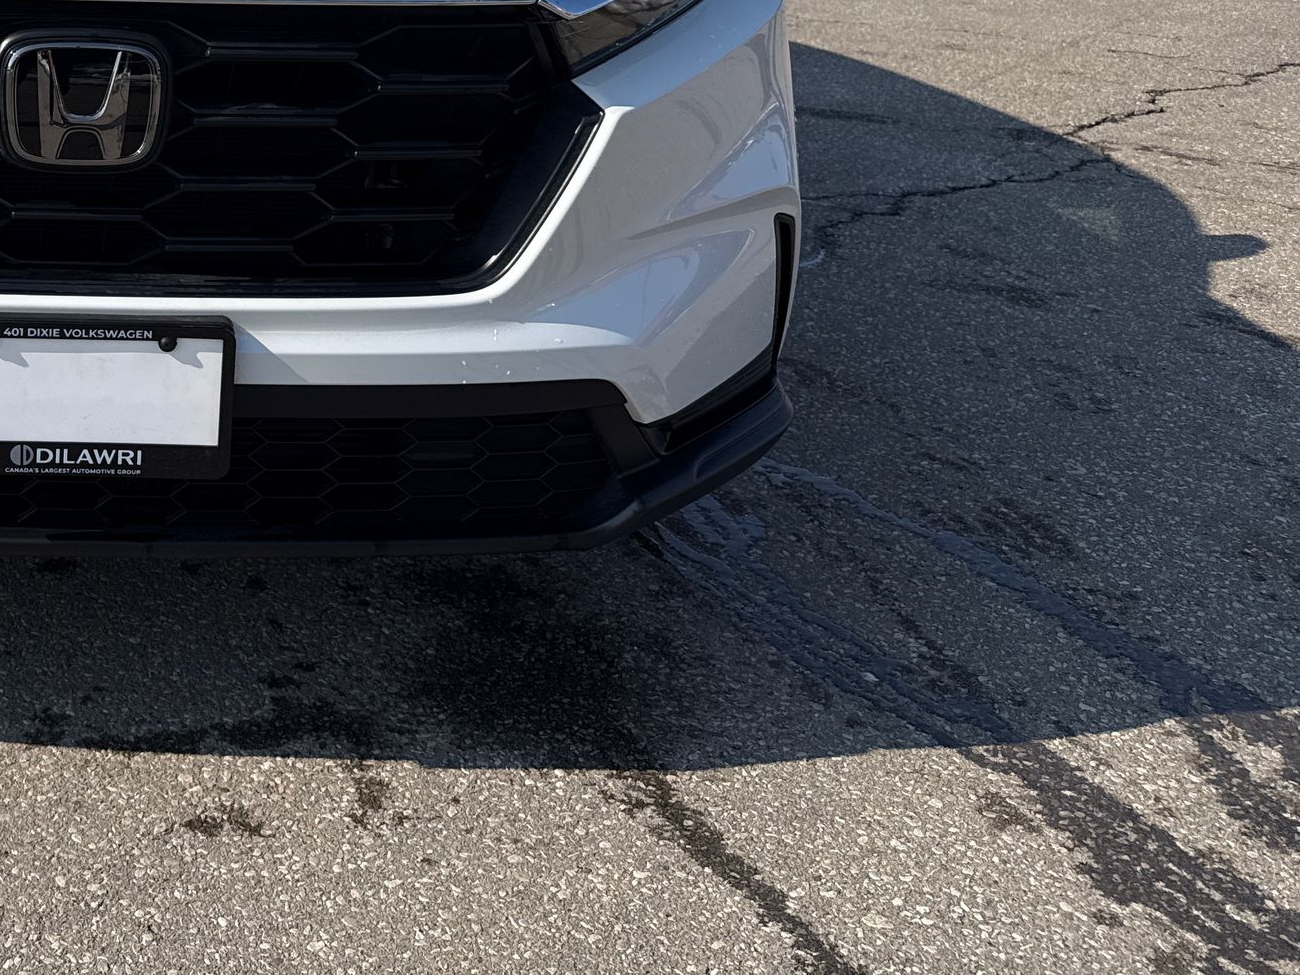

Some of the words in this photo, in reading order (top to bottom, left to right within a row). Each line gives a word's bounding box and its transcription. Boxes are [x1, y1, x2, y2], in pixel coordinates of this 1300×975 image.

[3, 327, 24, 337] 401
[27, 327, 60, 338] DIXIE
[63, 328, 153, 339] VOLKSWAGEN
[35, 447, 142, 465] DILAWRI
